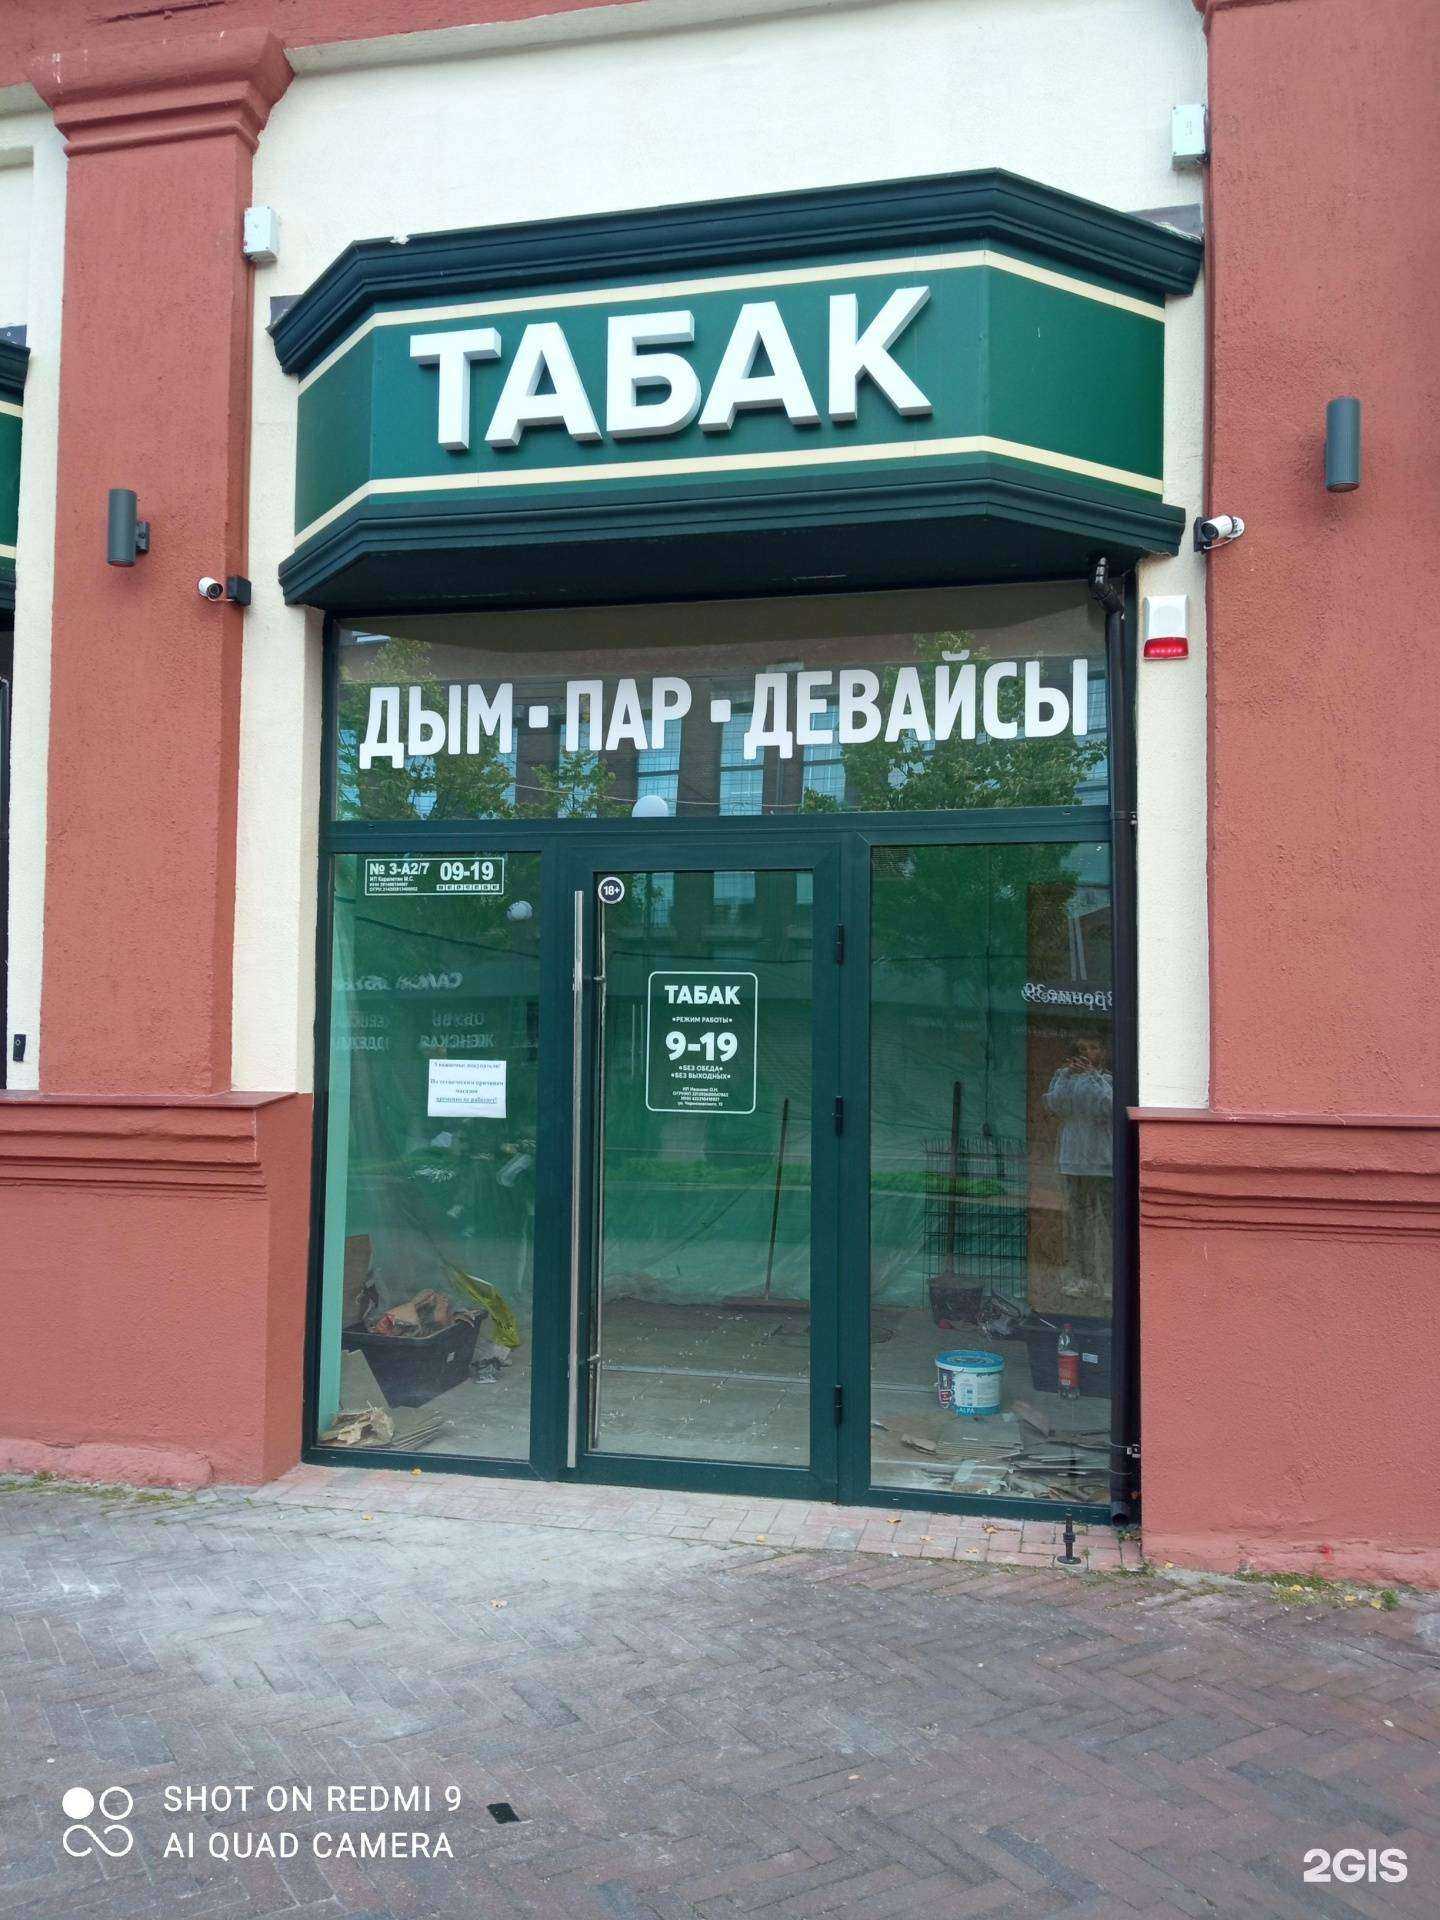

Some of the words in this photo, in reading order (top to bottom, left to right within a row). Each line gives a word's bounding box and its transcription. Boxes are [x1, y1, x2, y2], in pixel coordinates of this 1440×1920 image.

[410, 286, 933, 450] ТАБАК
[359, 682, 513, 770] ДЫМ
[565, 677, 692, 752] ПАР
[743, 650, 1089, 760] ДЕВАЙСЫ
[369, 862, 386, 875] №
[439, 861, 495, 881] 09-19
[603, 885, 620, 896] 18+
[664, 985, 741, 1005] ТАБАК
[675, 1016, 701, 1024] РЕЖИМ
[701, 1016, 729, 1024] РАБОТЫ
[665, 1031, 738, 1062] 9-19
